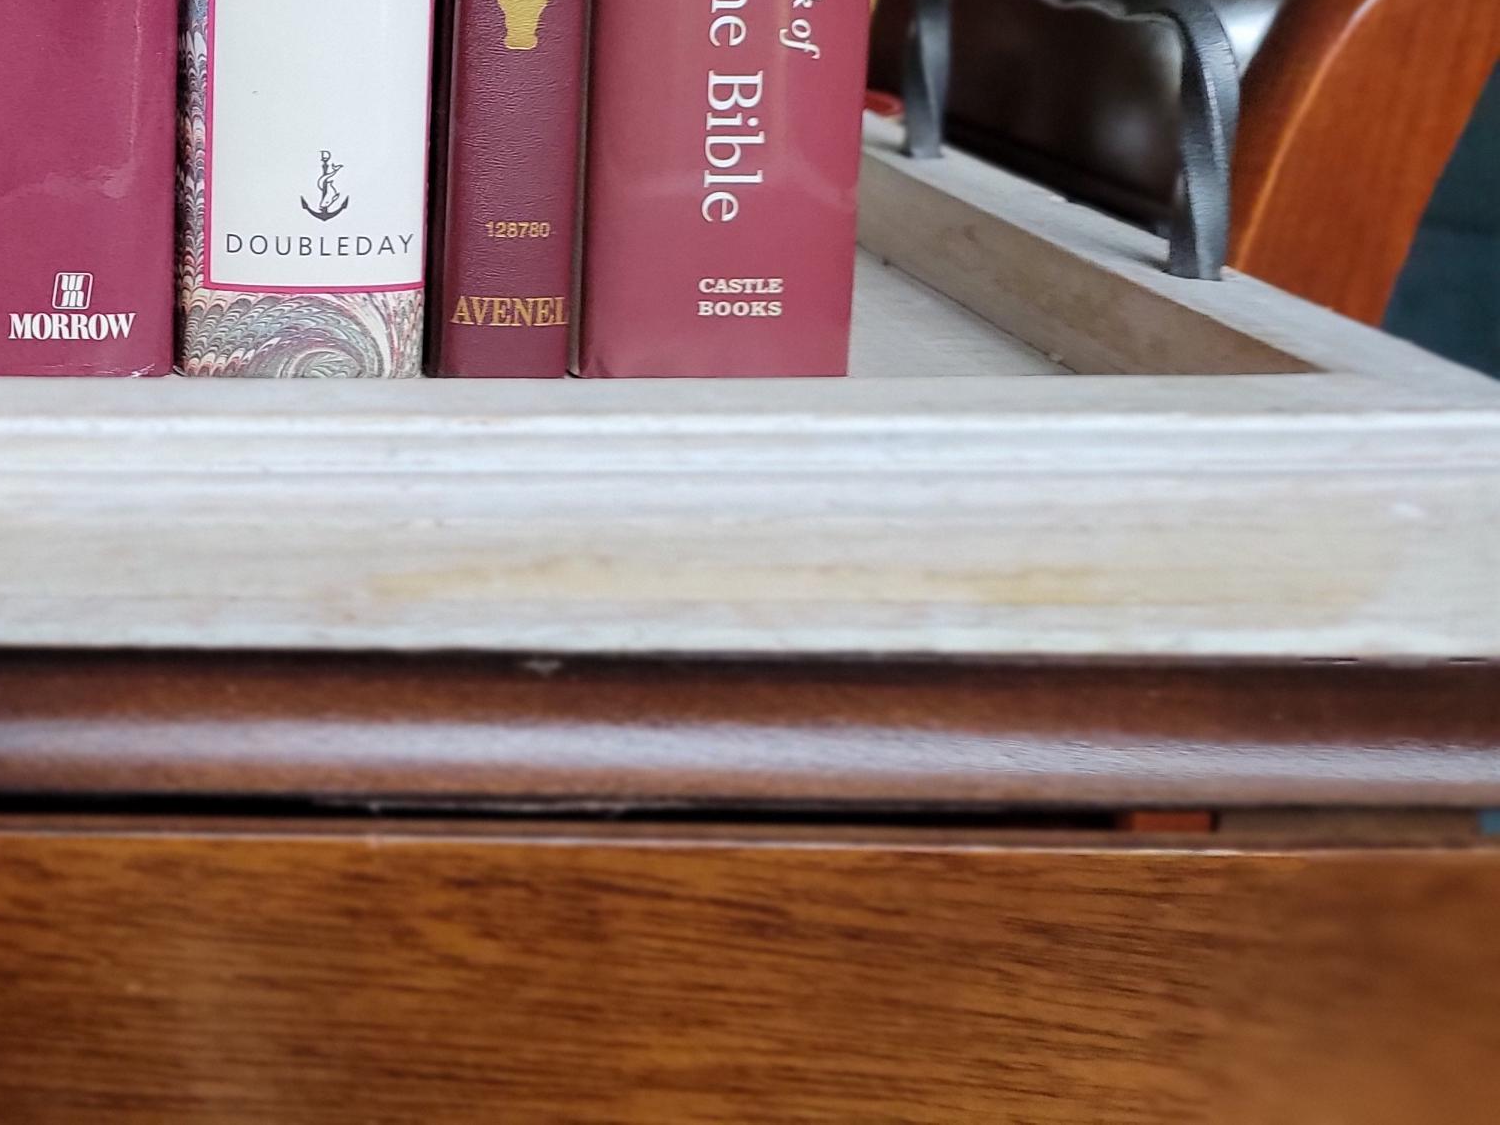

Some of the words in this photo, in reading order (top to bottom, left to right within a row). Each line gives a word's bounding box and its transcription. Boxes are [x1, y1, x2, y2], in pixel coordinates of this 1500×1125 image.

[779, 15, 820, 59] of
[701, 70, 766, 224] Bible
[484, 221, 551, 238] 128780
[225, 233, 416, 257] DOUBLEDAY
[699, 278, 784, 295] CASTLE
[698, 300, 783, 317] BOOKS
[8, 312, 137, 341] MORROW
